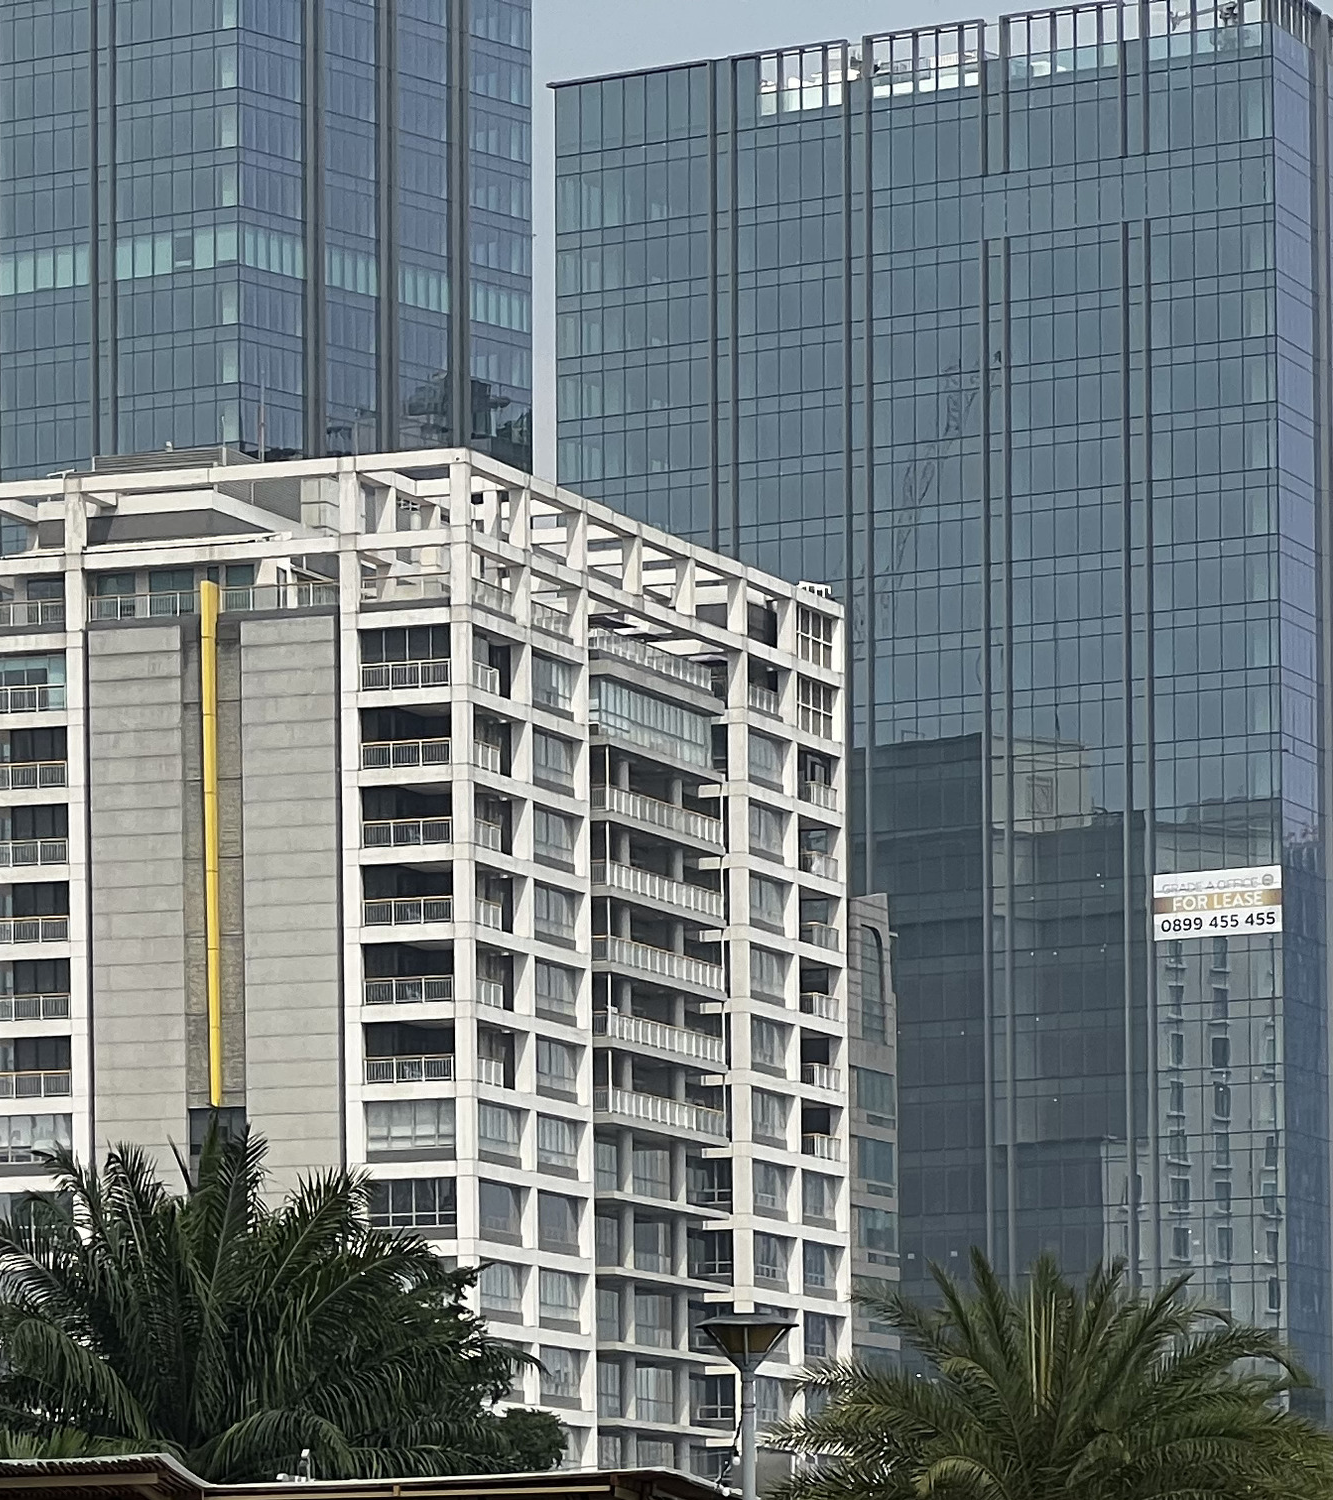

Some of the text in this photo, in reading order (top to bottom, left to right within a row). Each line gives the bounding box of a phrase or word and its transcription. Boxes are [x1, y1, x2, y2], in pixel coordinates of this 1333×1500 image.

[1173, 890, 1264, 912] FOR LEASE
[1161, 911, 1276, 932] 0899 455 455
